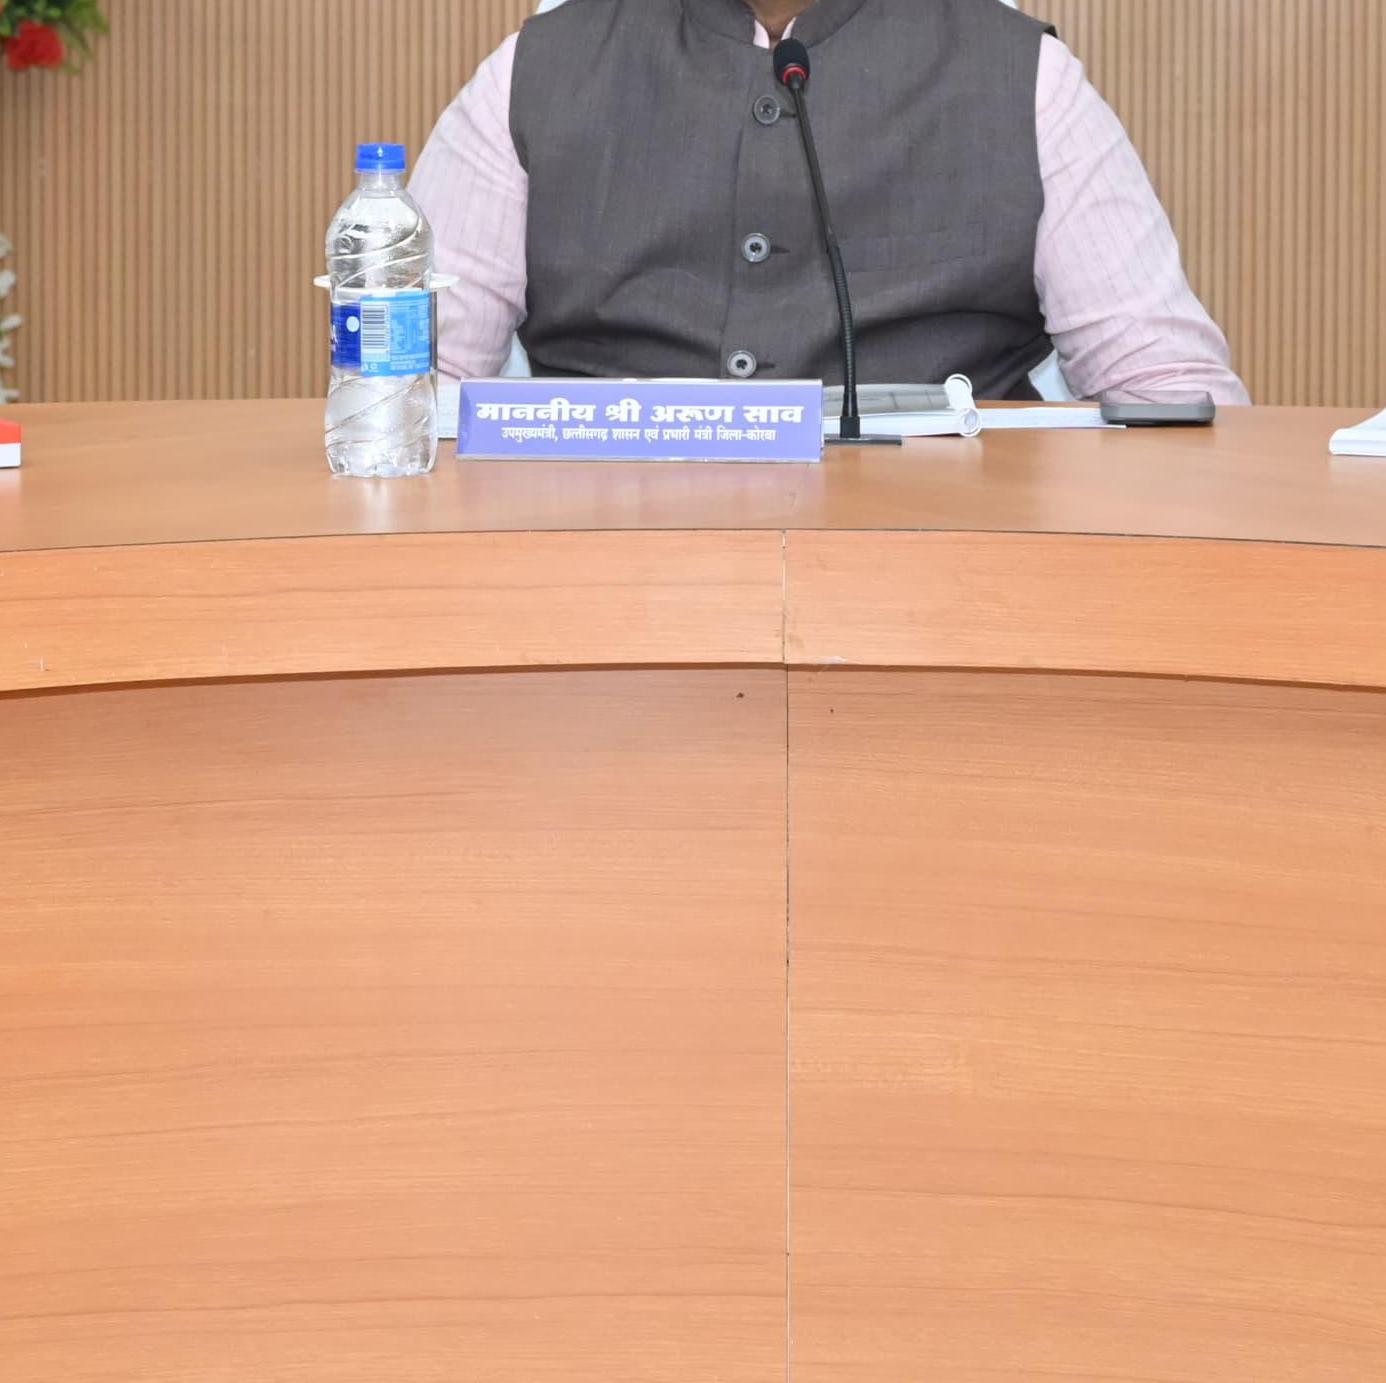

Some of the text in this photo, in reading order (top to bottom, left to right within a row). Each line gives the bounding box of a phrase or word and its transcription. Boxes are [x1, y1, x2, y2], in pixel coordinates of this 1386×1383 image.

[476, 398, 805, 424] माननीय श्री अरूण साव
[612, 428, 640, 441] शासन
[644, 425, 659, 443] एवं
[663, 425, 690, 441] प्रभारी
[693, 425, 713, 441] मंत्री
